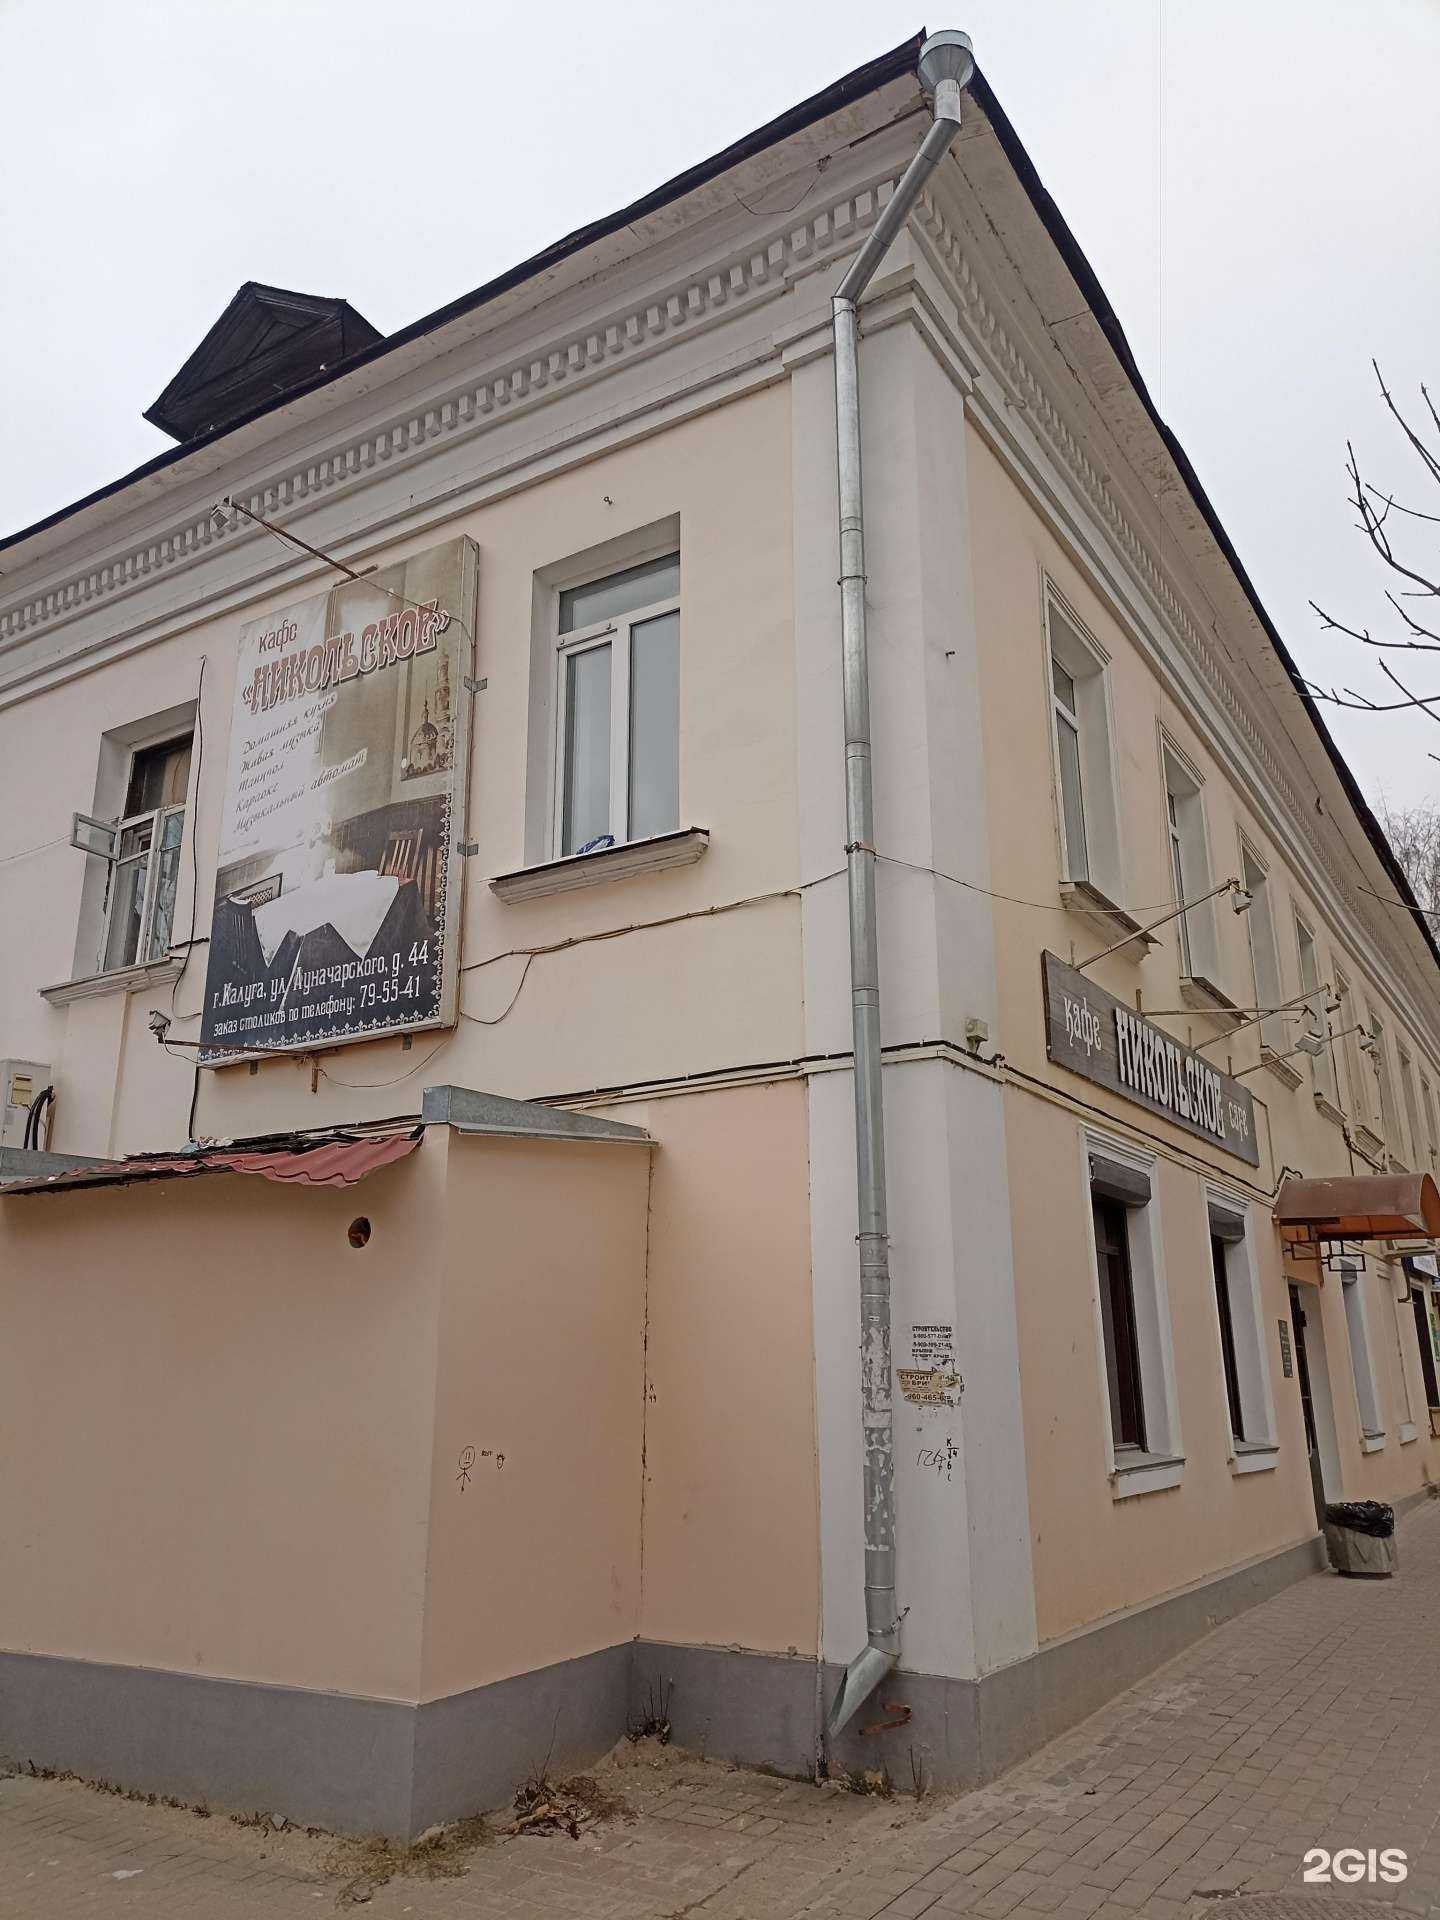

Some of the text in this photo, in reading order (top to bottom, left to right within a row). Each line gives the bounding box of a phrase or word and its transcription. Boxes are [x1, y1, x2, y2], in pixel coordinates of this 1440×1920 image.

[258, 617, 298, 654] кафе
[408, 940, 429, 966] 44
[213, 975, 420, 1036] заказ столиков по телефону: 79-55-41
[1115, 1006, 1226, 1139] НИКОЛЬСКОЕ
